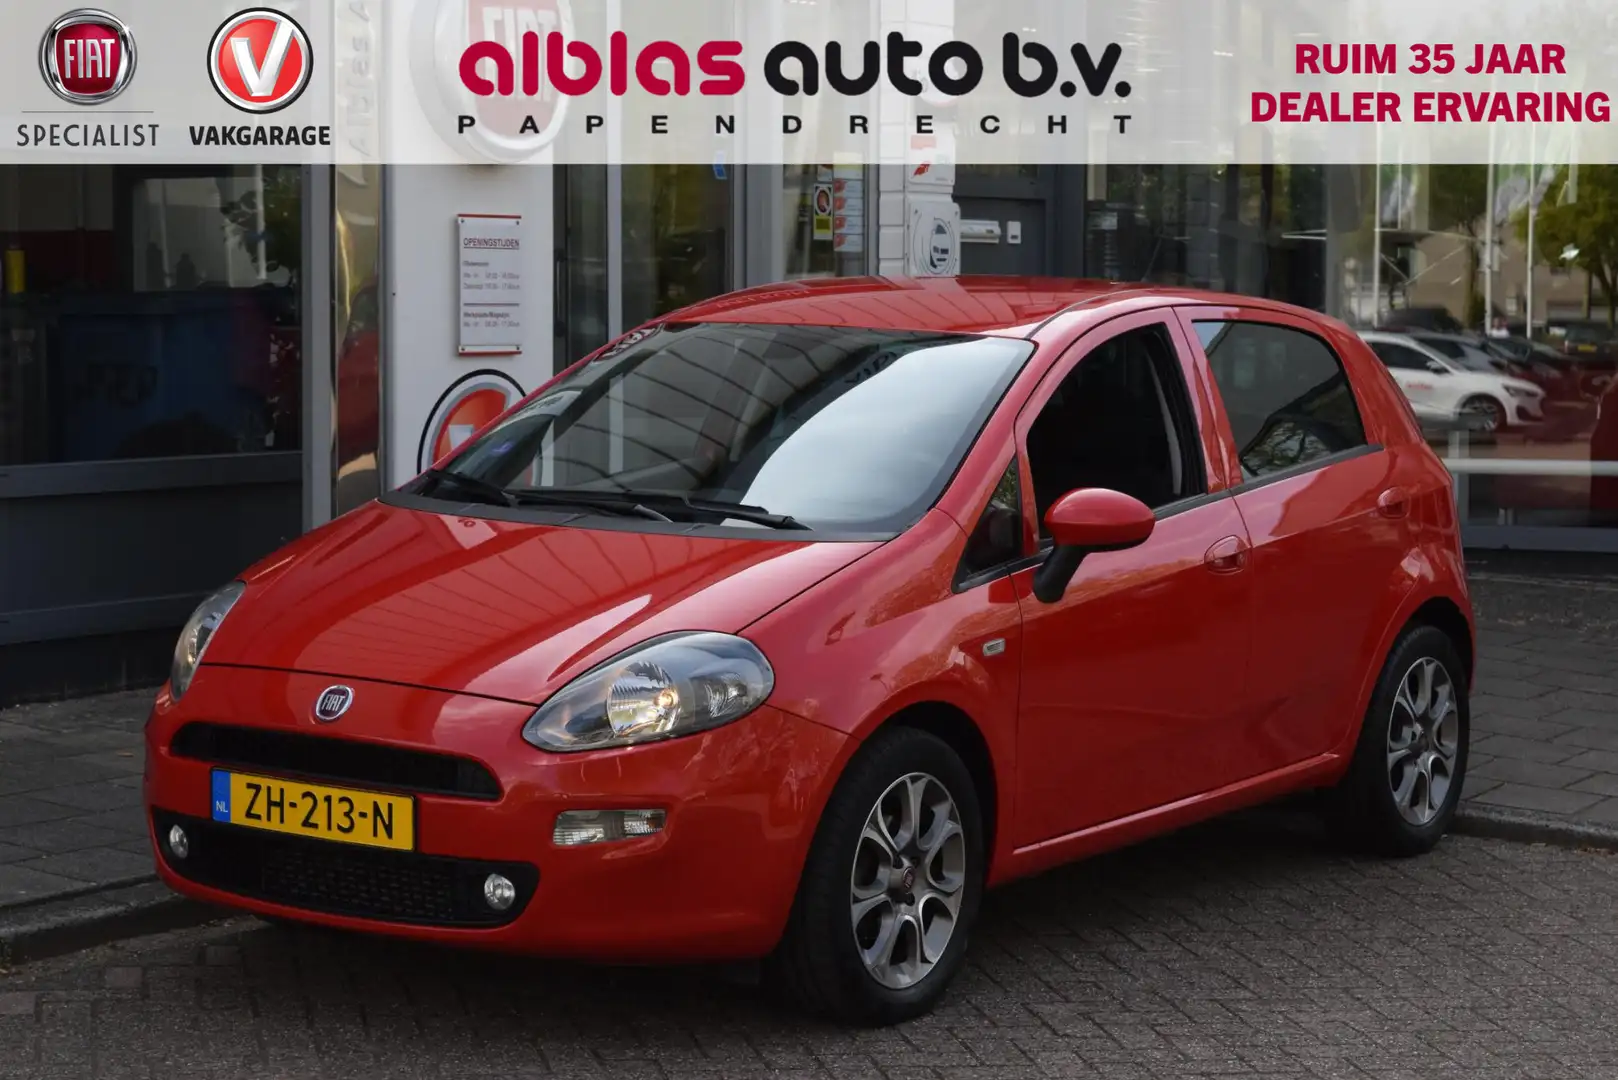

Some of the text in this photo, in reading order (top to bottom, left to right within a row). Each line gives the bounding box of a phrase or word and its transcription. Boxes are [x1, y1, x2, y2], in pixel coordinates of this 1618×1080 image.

[321, 694, 346, 712] FIAT
[215, 800, 228, 813] NL
[244, 782, 394, 840] ZH-213-N
